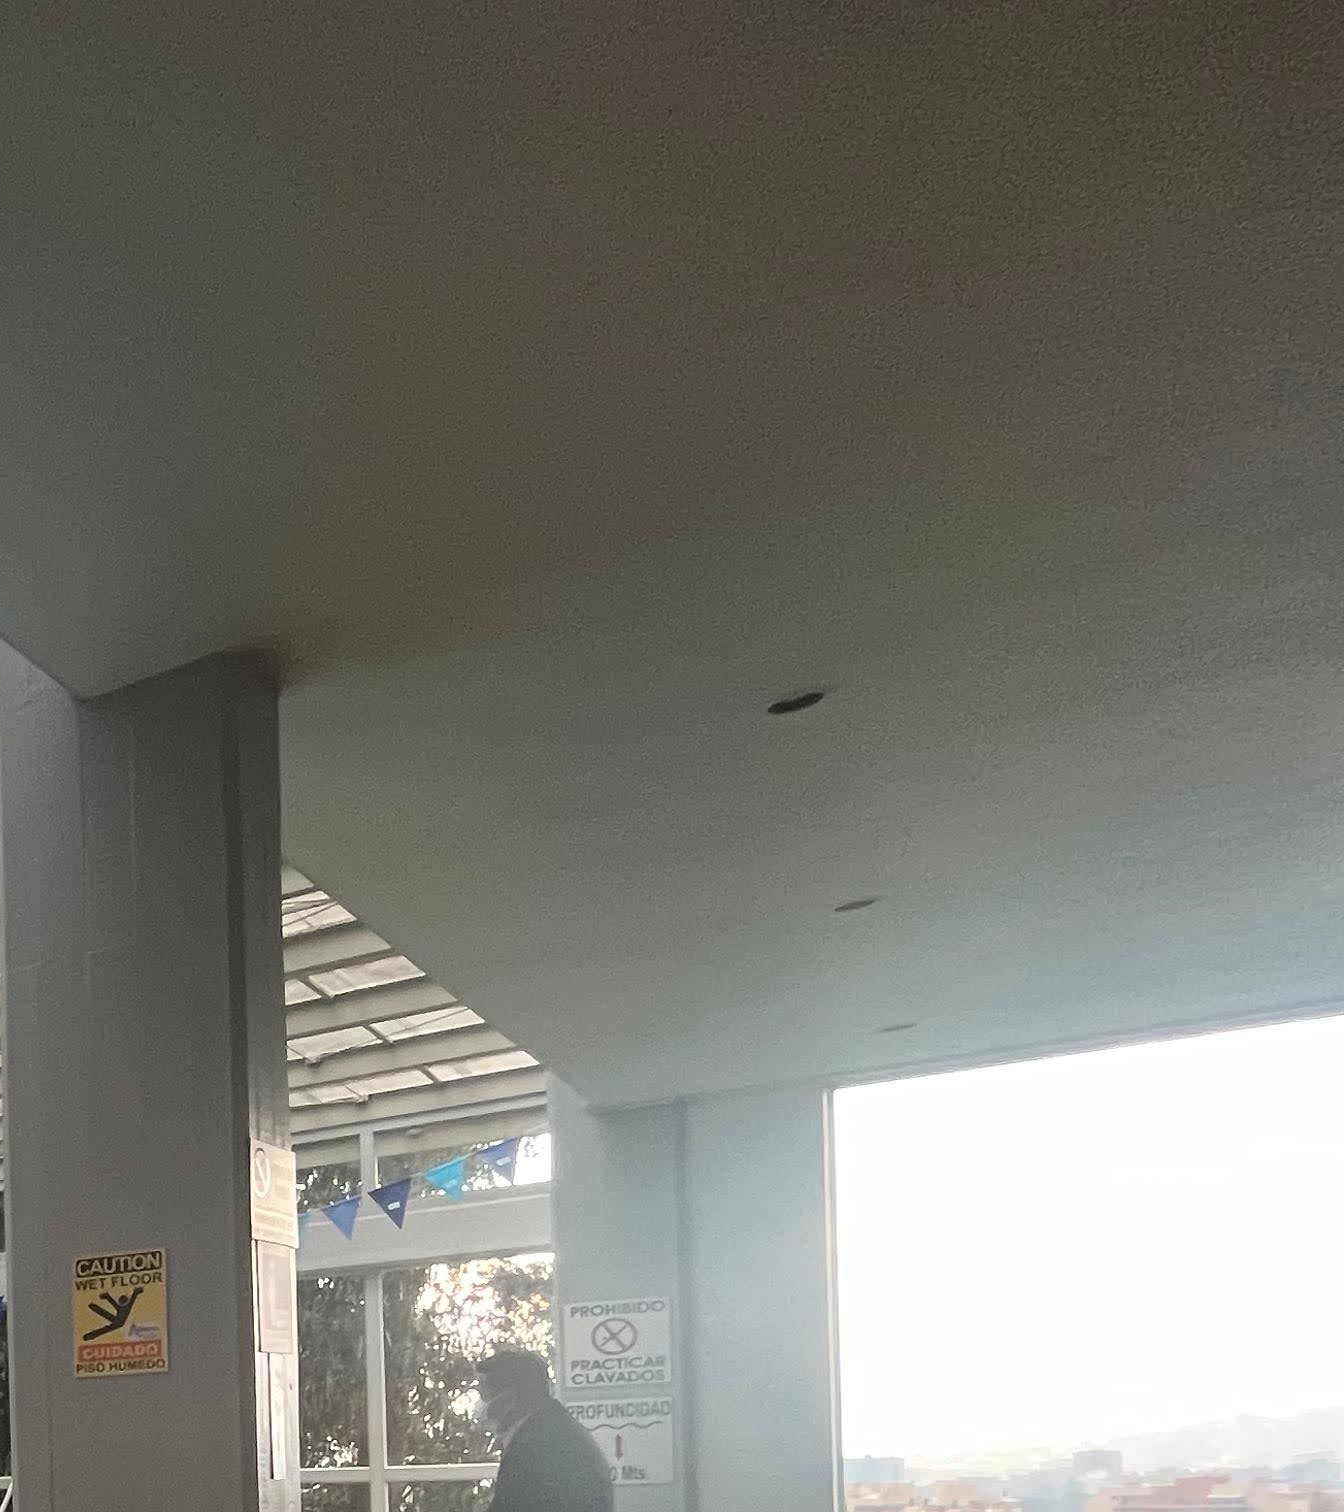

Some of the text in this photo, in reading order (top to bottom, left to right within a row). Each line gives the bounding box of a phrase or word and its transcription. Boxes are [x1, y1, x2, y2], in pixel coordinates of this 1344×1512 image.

[79, 1254, 160, 1275] CAUTION
[75, 1272, 163, 1290] WET FLOOR
[570, 1301, 665, 1317] PROHIBIDO
[82, 1344, 159, 1358] CUIDADO
[76, 1359, 165, 1373] PISO HUMEDO
[571, 1355, 666, 1371] PRACTICAR
[571, 1370, 665, 1384] CLAVADOS
